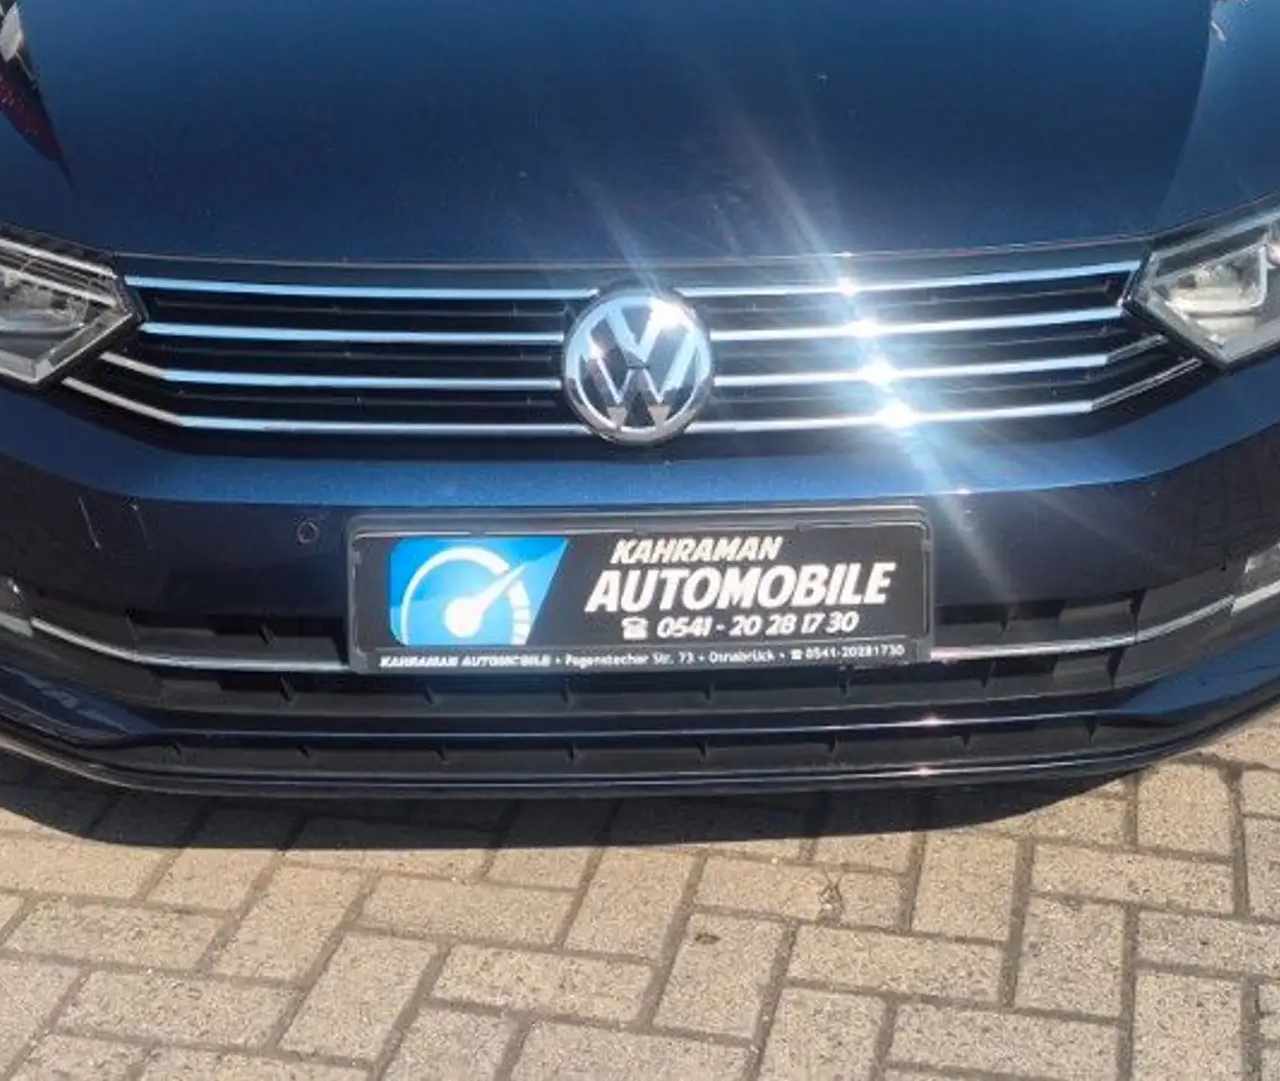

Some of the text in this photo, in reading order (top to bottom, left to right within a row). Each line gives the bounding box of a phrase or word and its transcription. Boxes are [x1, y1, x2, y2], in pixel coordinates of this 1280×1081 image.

[609, 535, 784, 565] KAHRAMAN
[583, 561, 897, 613] AUTOMOBILE
[656, 616, 714, 638] 0541
[728, 614, 763, 638] 20
[765, 613, 797, 637] 28
[800, 612, 826, 635] 17
[825, 611, 861, 634] 30
[378, 654, 459, 669] KAHRAMAN
[461, 653, 551, 668] AUTOMOBILE
